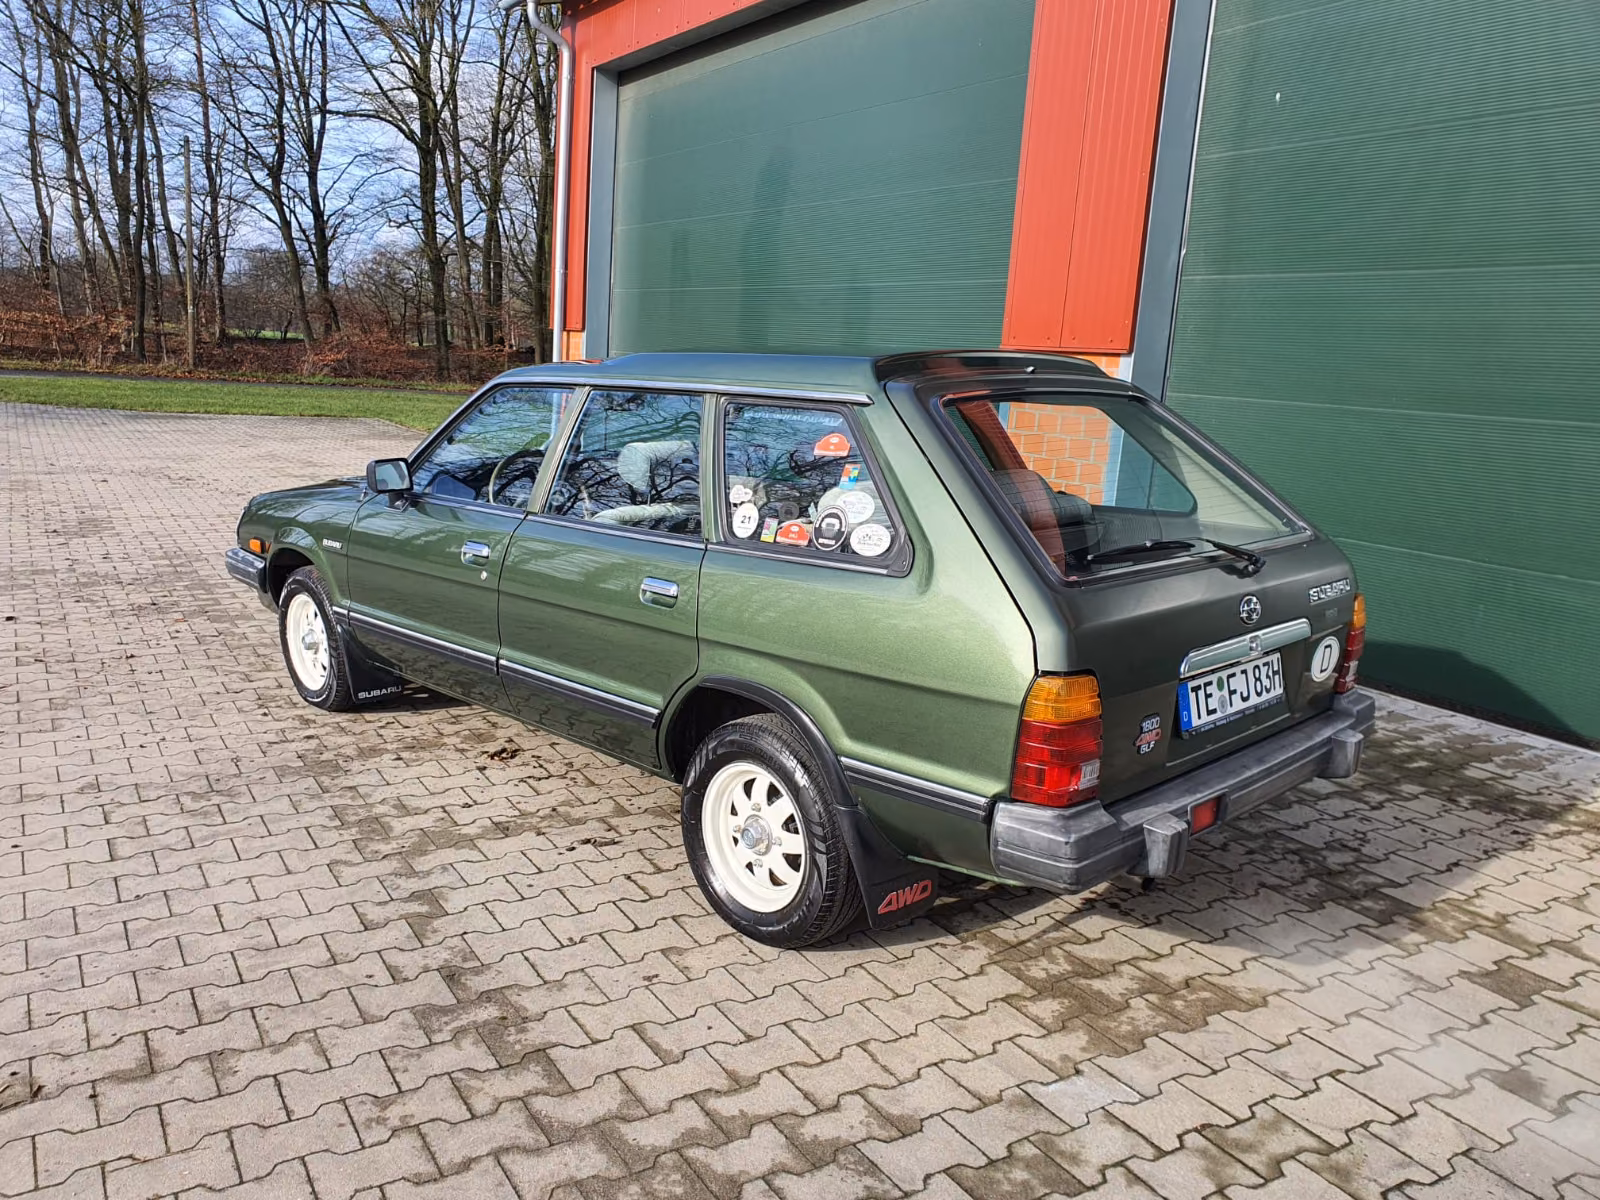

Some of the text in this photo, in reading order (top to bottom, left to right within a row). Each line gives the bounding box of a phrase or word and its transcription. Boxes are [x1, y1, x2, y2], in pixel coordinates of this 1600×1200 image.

[741, 515, 752, 524] 21
[1309, 579, 1351, 603] SUBARU
[1320, 644, 1333, 674] D
[358, 685, 402, 699] SUBARU
[1190, 657, 1282, 720] TE FJ 83H
[1183, 711, 1189, 722] D
[1141, 717, 1160, 733] 1800
[1140, 740, 1156, 754] GLF
